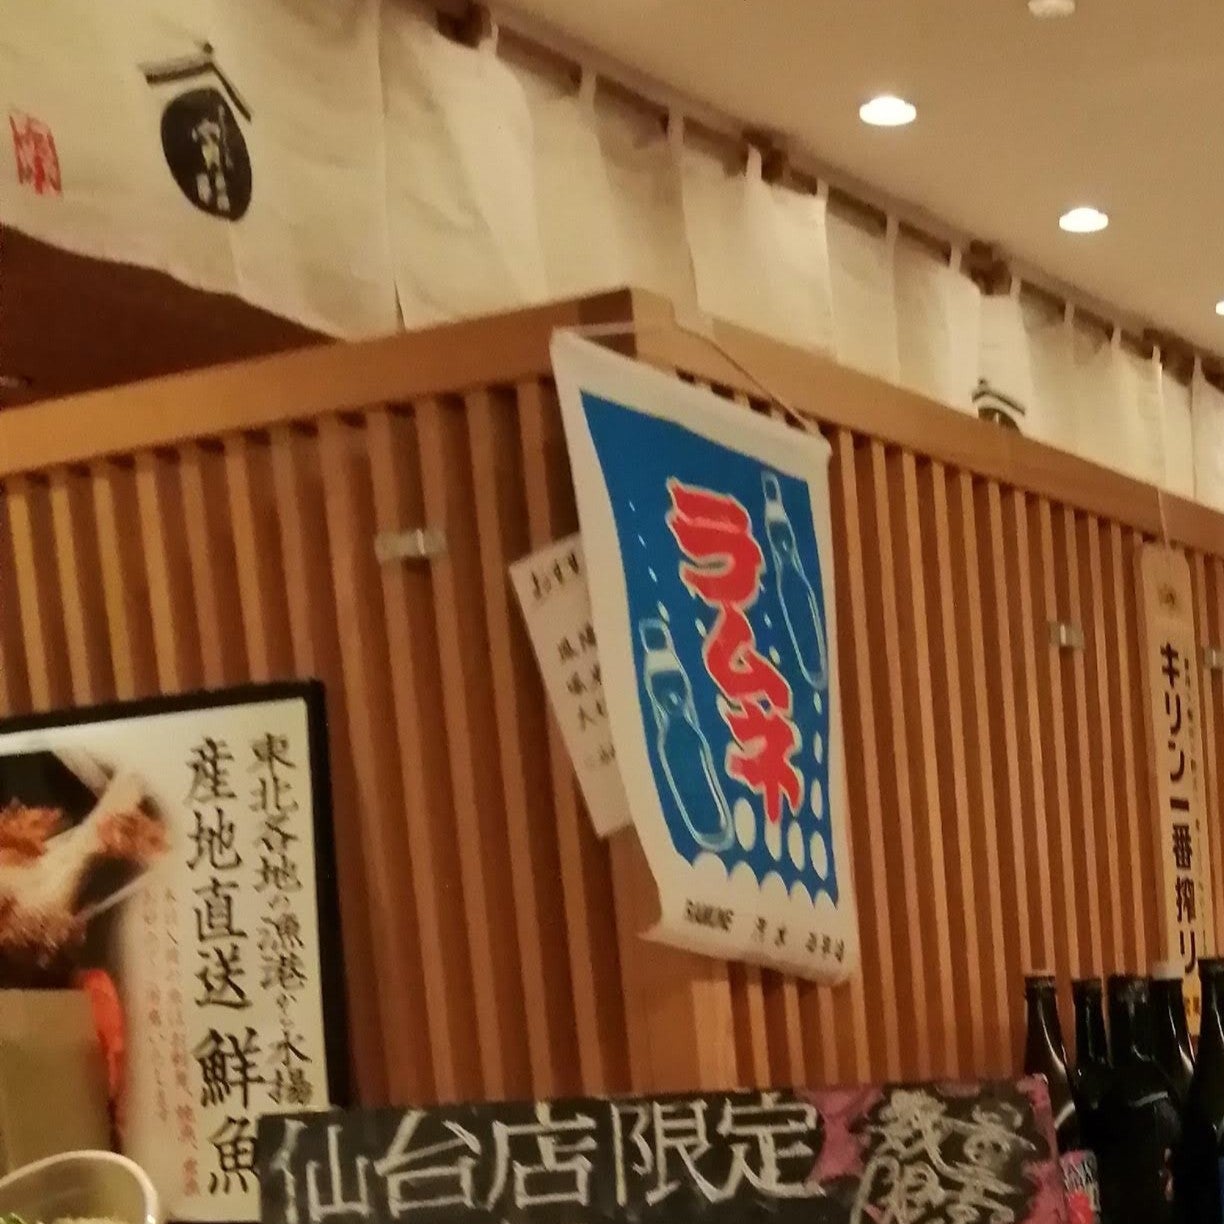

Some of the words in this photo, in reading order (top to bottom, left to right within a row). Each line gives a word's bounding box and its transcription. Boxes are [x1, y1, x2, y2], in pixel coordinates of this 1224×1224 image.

[664, 476, 803, 825] ラムネ
[1159, 642, 1198, 974] キリン一番搾り
[184, 737, 262, 1194] 産地直送鮮魚
